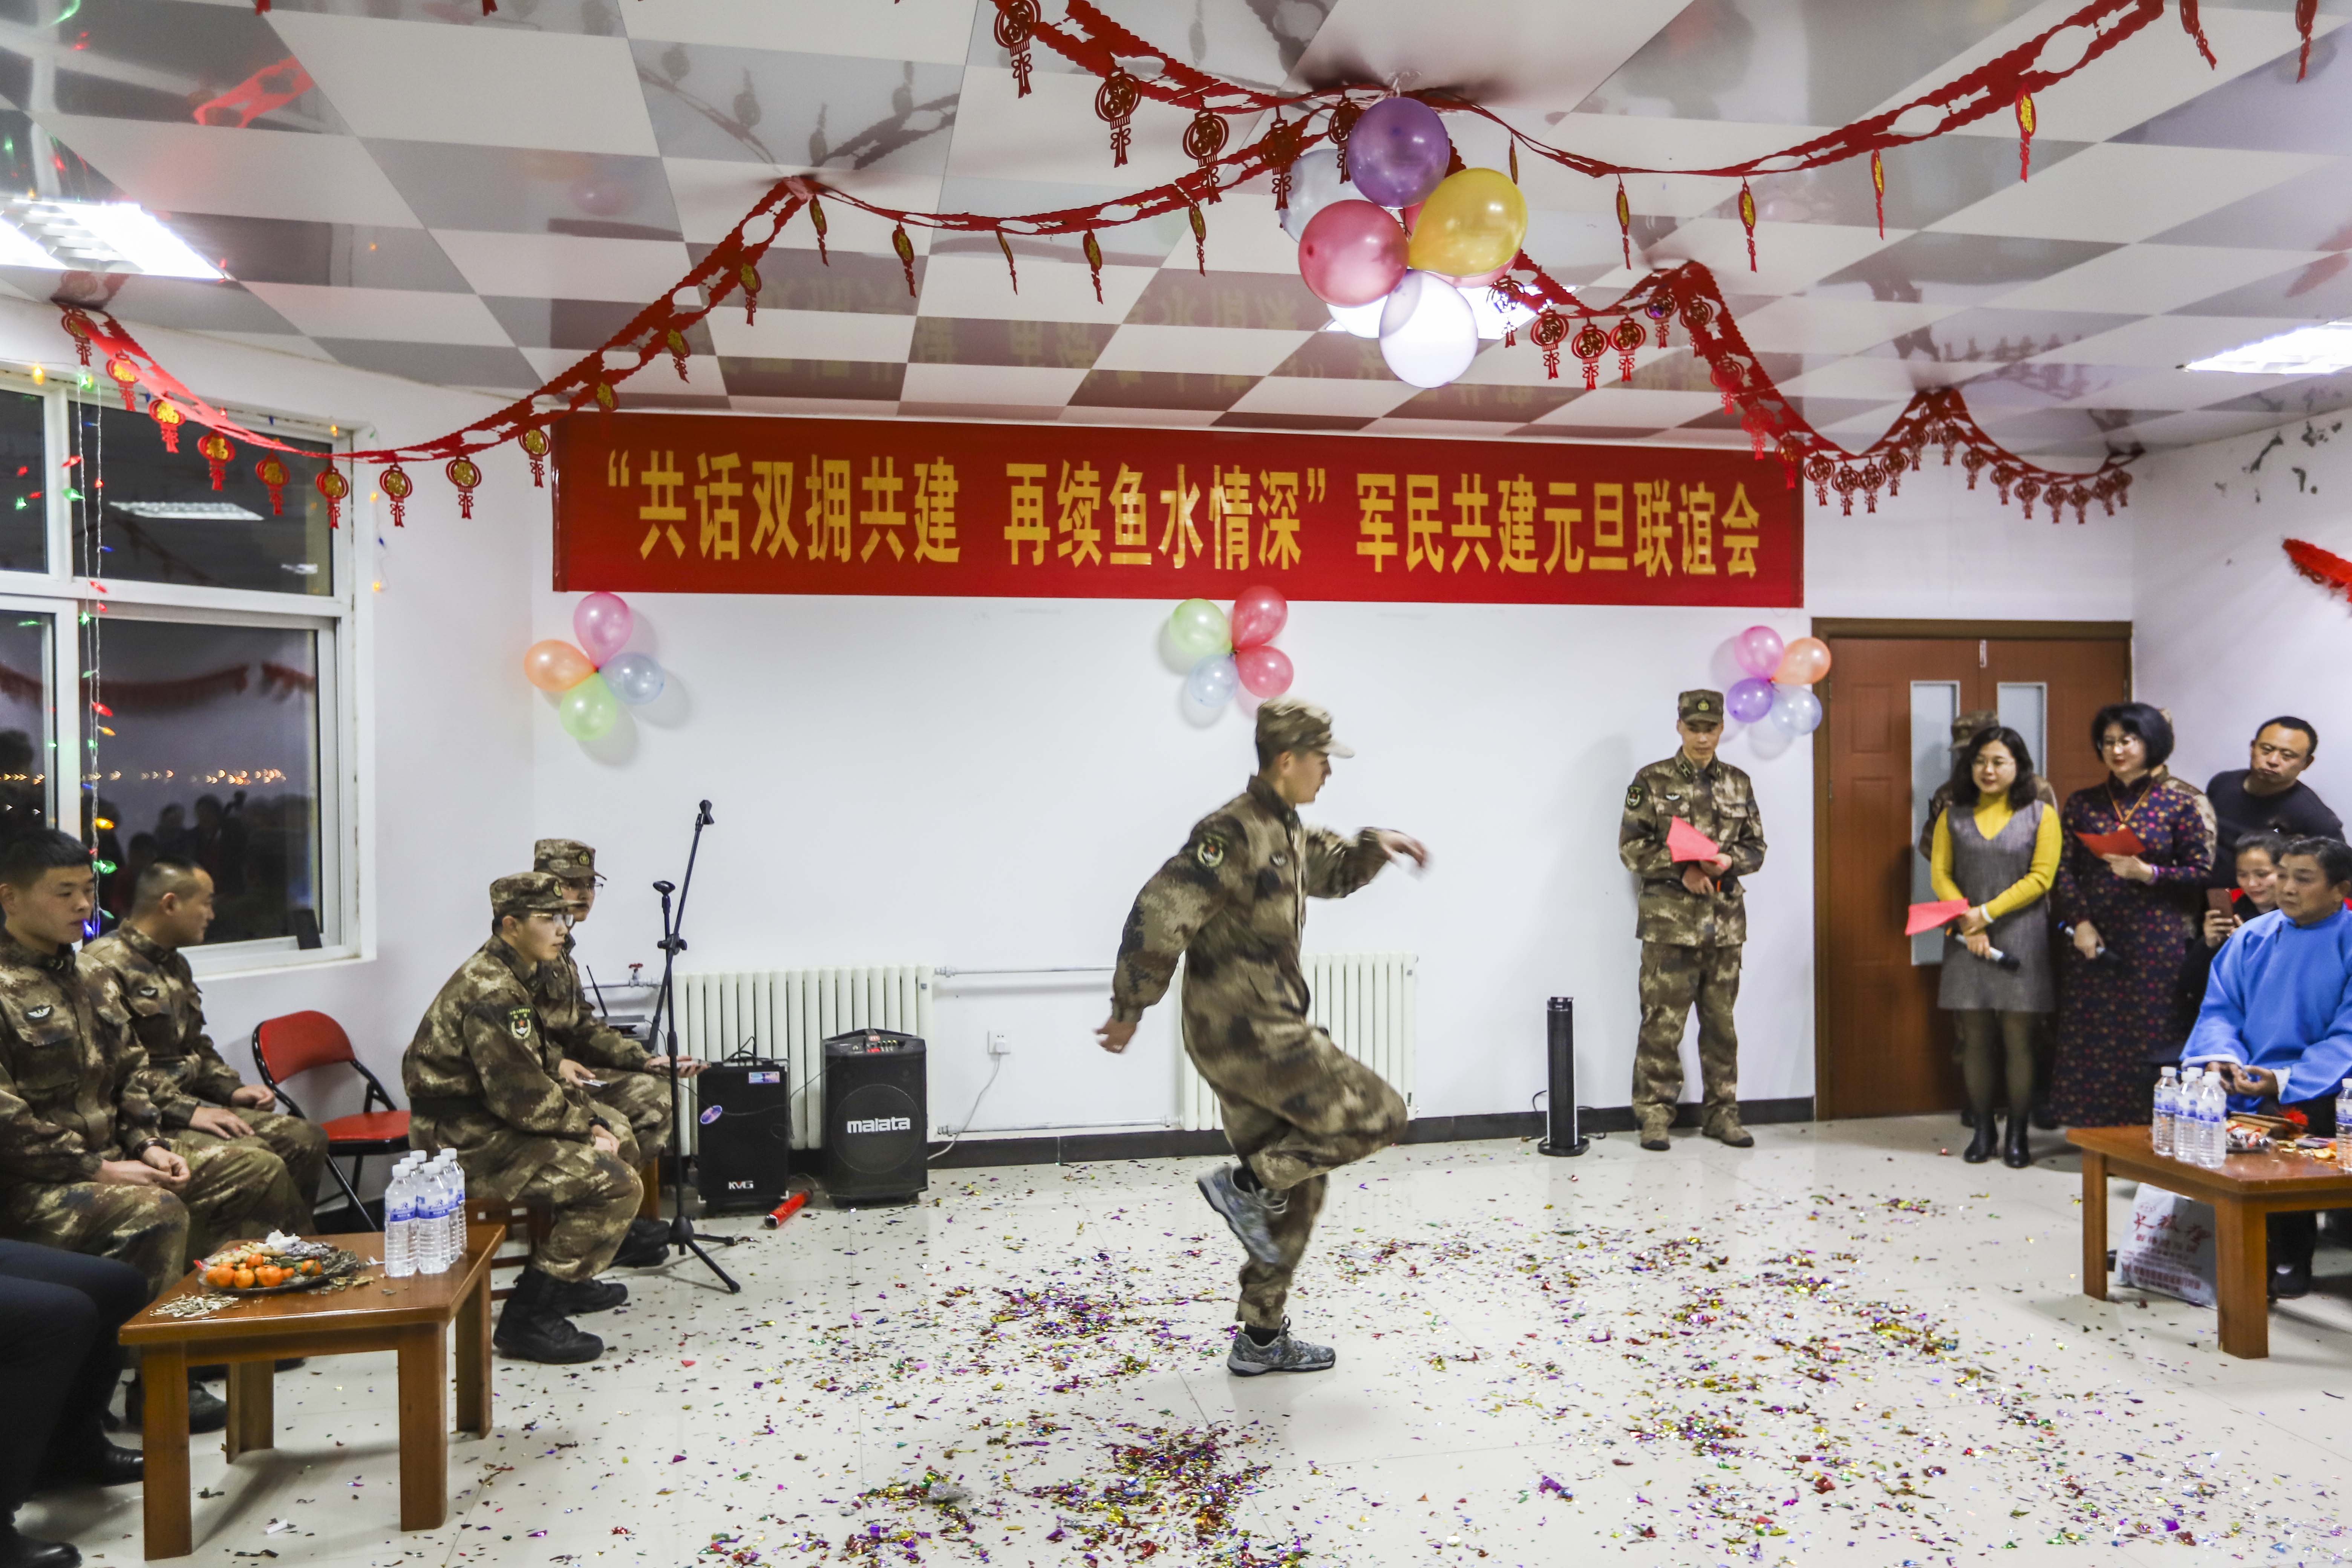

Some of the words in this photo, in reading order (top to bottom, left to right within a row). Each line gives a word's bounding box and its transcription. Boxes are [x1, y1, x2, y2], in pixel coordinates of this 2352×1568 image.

[608, 450, 961, 564] “共话双拥共建
[1004, 459, 1326, 571] 再续鱼水情深”
[1356, 473, 1760, 578] 军民共建元旦联谊会
[847, 1116, 910, 1133] malata
